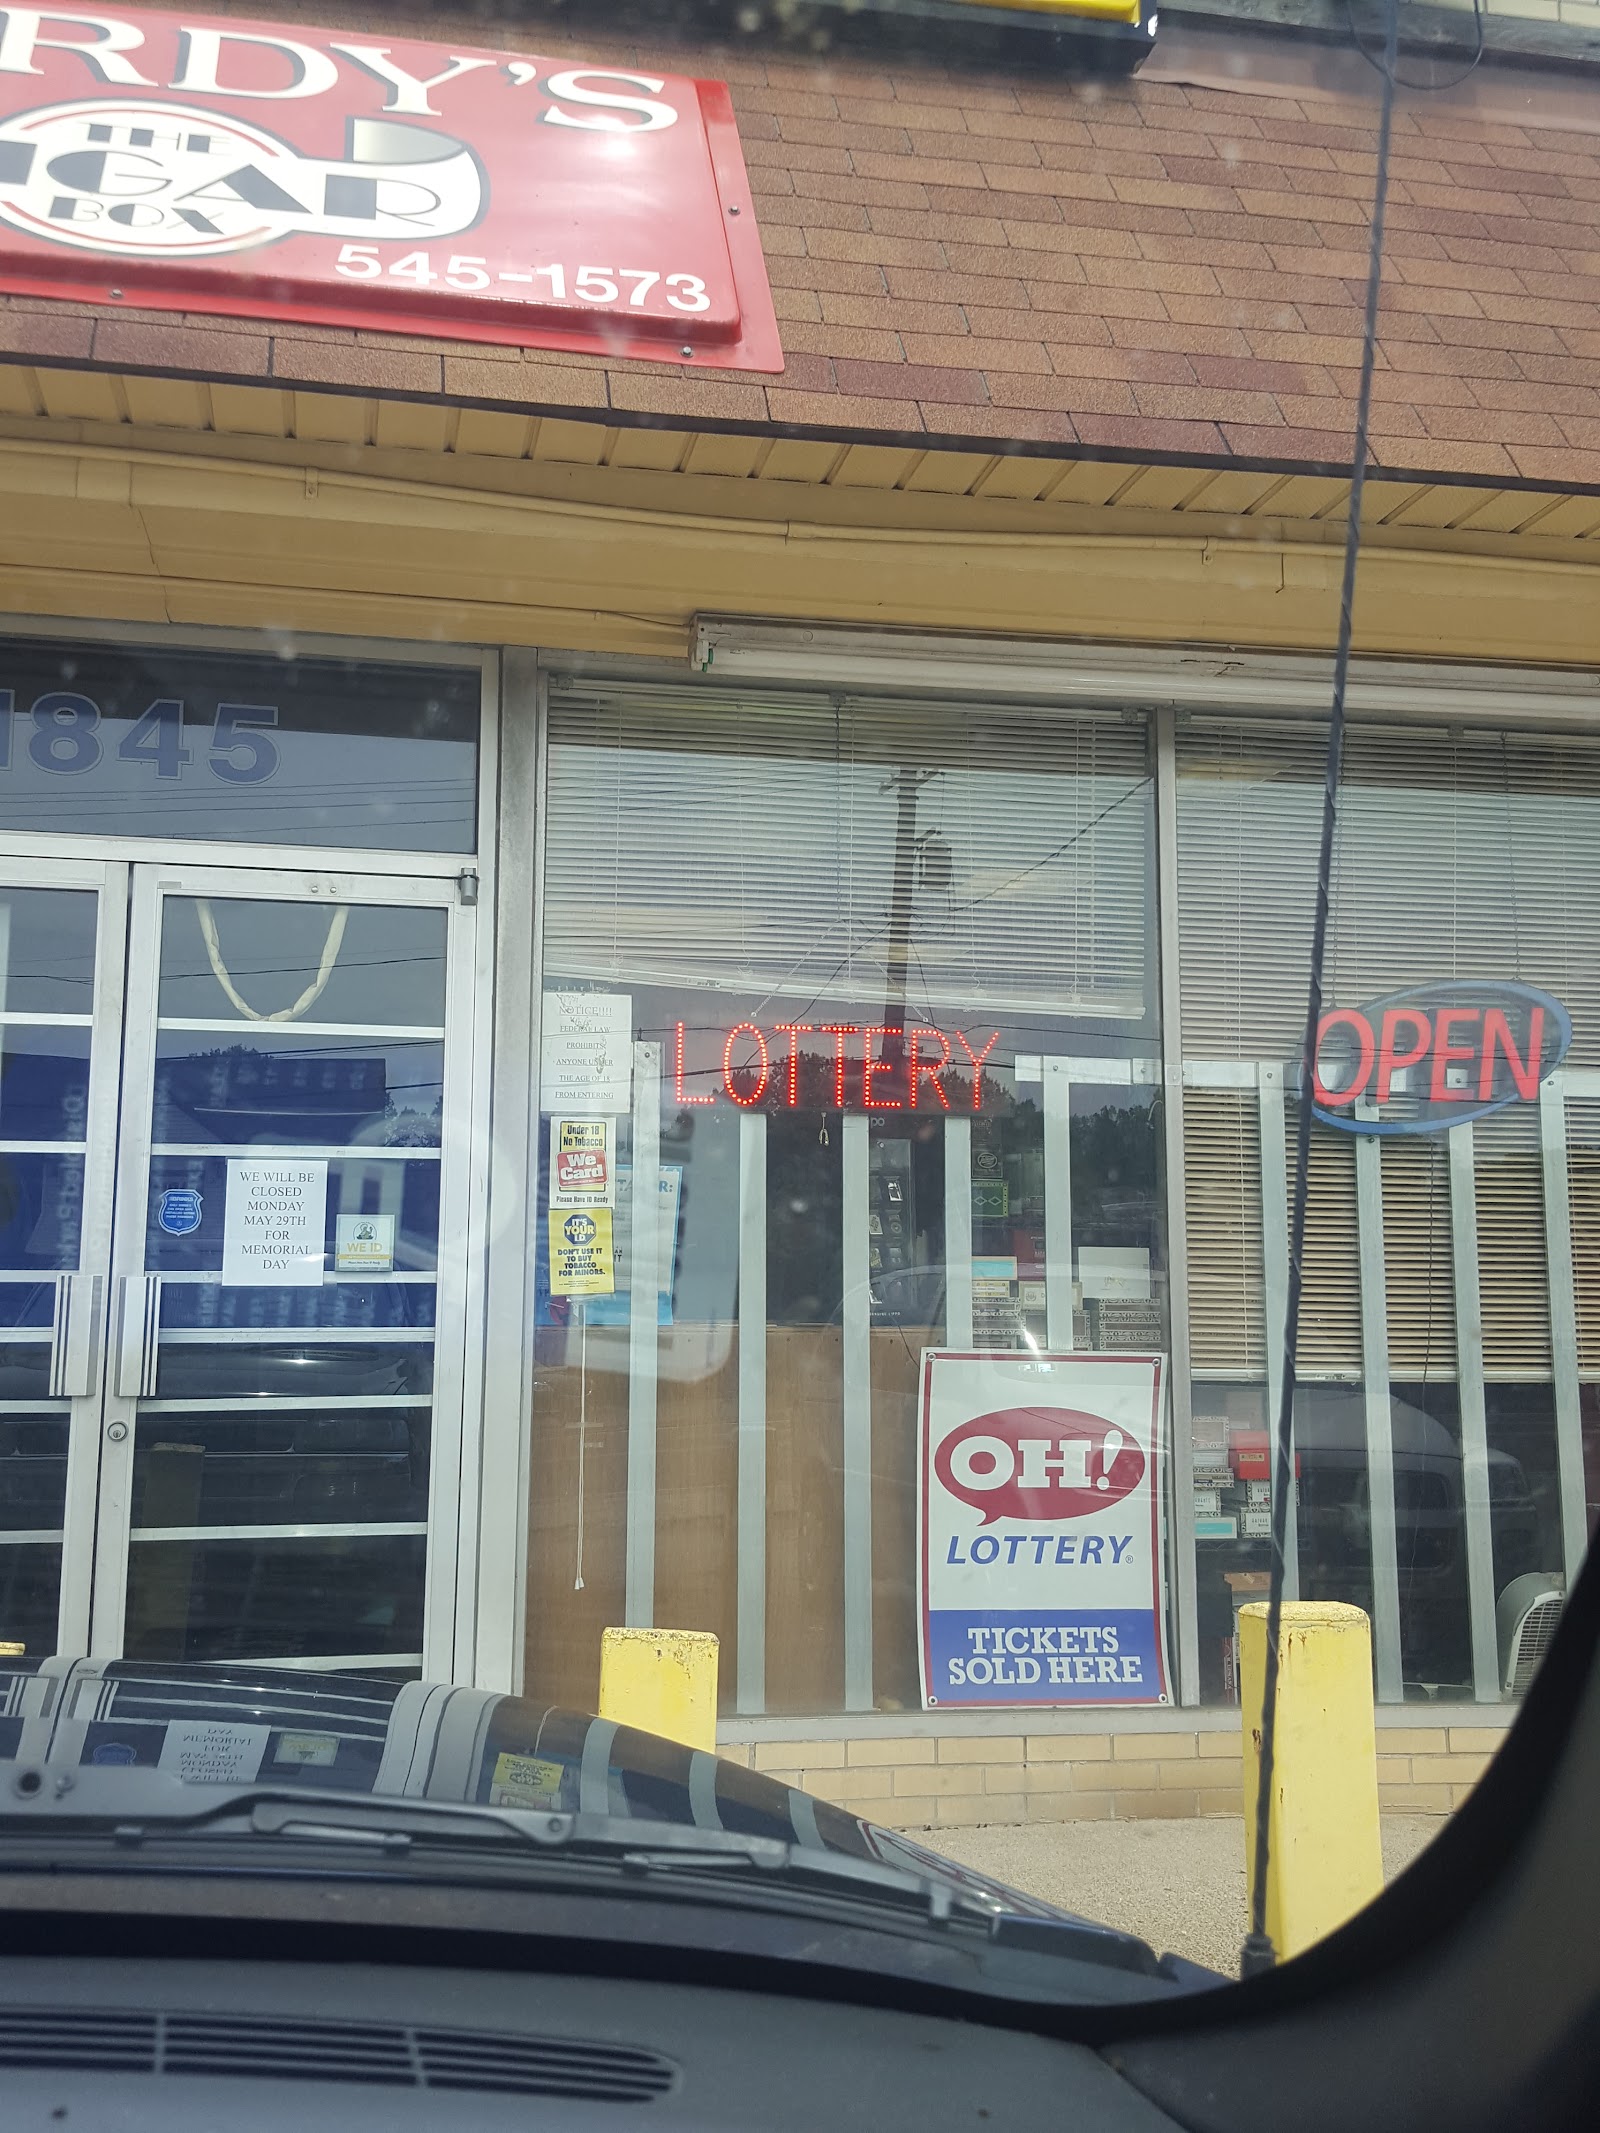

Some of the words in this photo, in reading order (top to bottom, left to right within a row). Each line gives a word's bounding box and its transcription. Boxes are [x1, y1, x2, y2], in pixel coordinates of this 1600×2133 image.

[76, 121, 233, 157] THE
[48, 195, 226, 236] BOX
[335, 243, 712, 313] 545-1573
[566, 1042, 606, 1050] PROHIBITS
[1312, 1007, 1544, 1106] OPEN
[556, 1058, 587, 1066] ANYONE
[675, 1020, 1000, 1109] LOTTERY
[560, 1074, 575, 1082] THE
[555, 1091, 576, 1099] FROM
[567, 1125, 588, 1135] Under
[591, 1126, 599, 1135] 18
[563, 1136, 573, 1146] No
[574, 1137, 603, 1146] Tobacco
[567, 1153, 597, 1167] We
[240, 1172, 260, 1182] WE
[264, 1172, 295, 1182] WILL
[299, 1173, 315, 1183] BE
[560, 1165, 604, 1180] Card
[251, 1187, 302, 1197] CLOSED
[594, 1196, 608, 1204] Ready
[247, 1201, 305, 1212] MONDAY
[244, 1216, 273, 1226] MAY
[276, 1216, 306, 1226] 29TH
[572, 1218, 588, 1226] IT'S
[265, 1230, 290, 1240] FOR
[564, 1225, 595, 1235] YOUR
[241, 1245, 312, 1255] MEMORIAL
[347, 1243, 367, 1252] WE
[370, 1243, 382, 1252] ID
[263, 1260, 290, 1270] DAY
[950, 1430, 1123, 1490] OH!
[947, 1536, 1133, 1564] LOTTERY
[968, 1627, 1119, 1654] TICKETS
[949, 1657, 1041, 1685] SOLD
[1049, 1657, 1142, 1683] HERE
